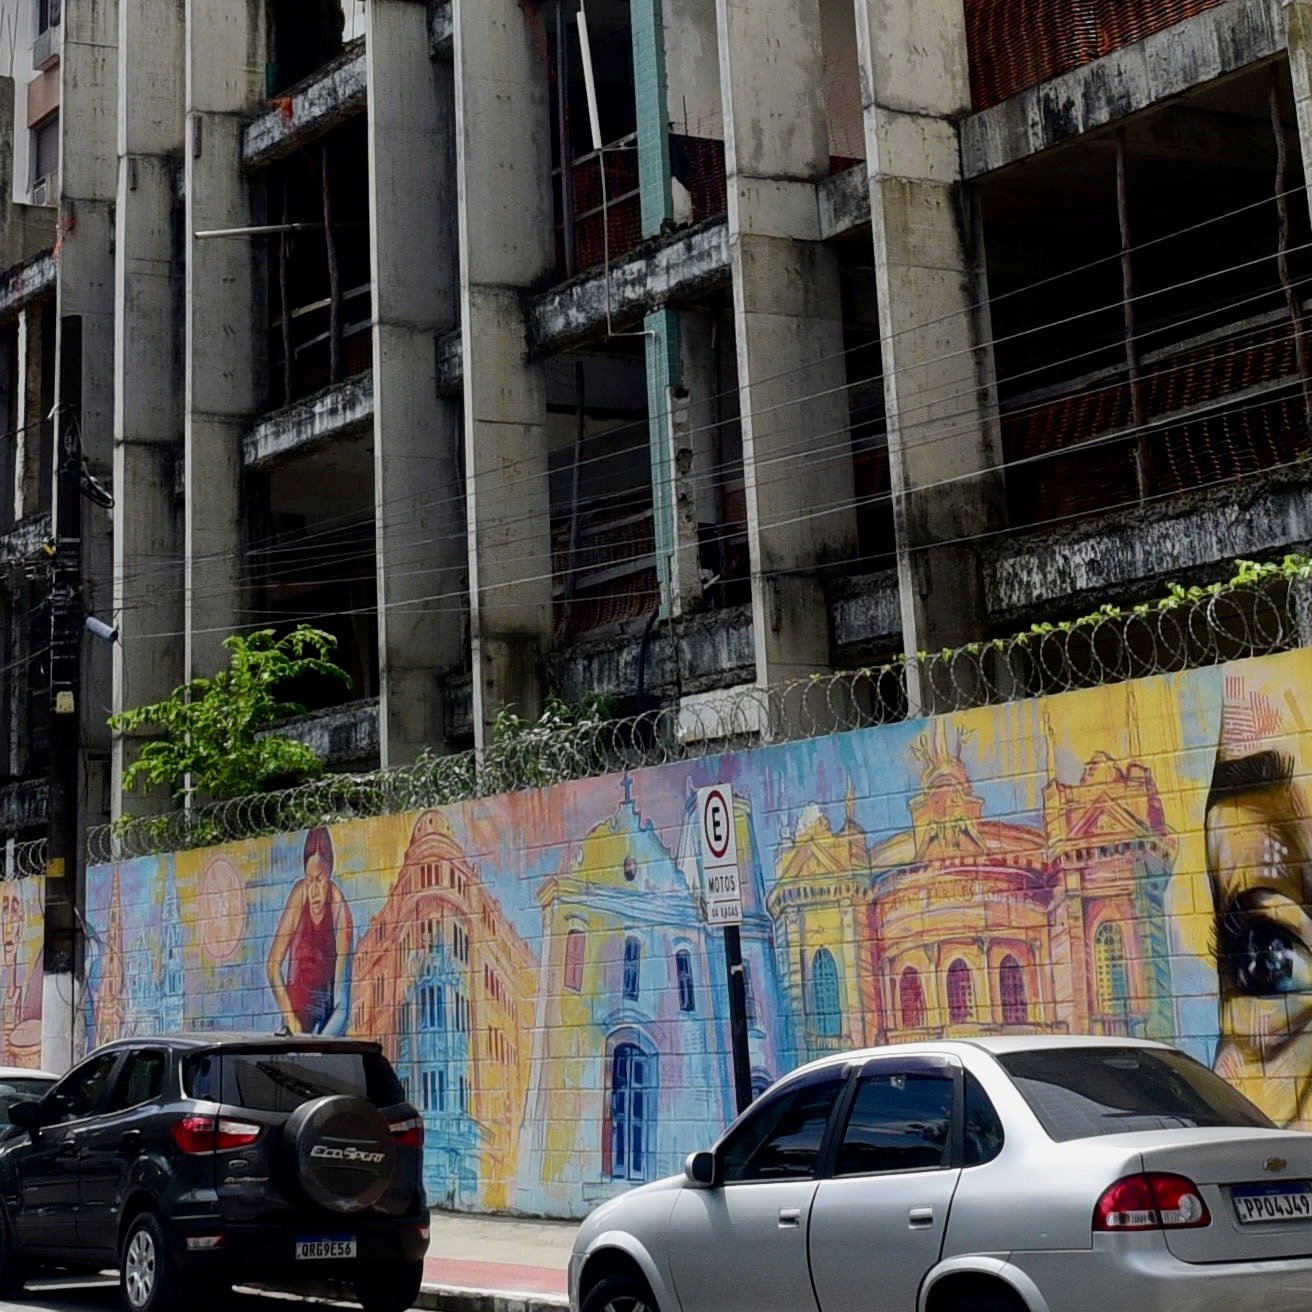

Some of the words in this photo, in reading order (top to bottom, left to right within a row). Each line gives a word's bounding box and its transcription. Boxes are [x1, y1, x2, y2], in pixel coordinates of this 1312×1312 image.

[711, 806, 723, 842] E
[708, 875, 736, 894] MOTOS
[301, 1242, 351, 1257] QRG9E56
